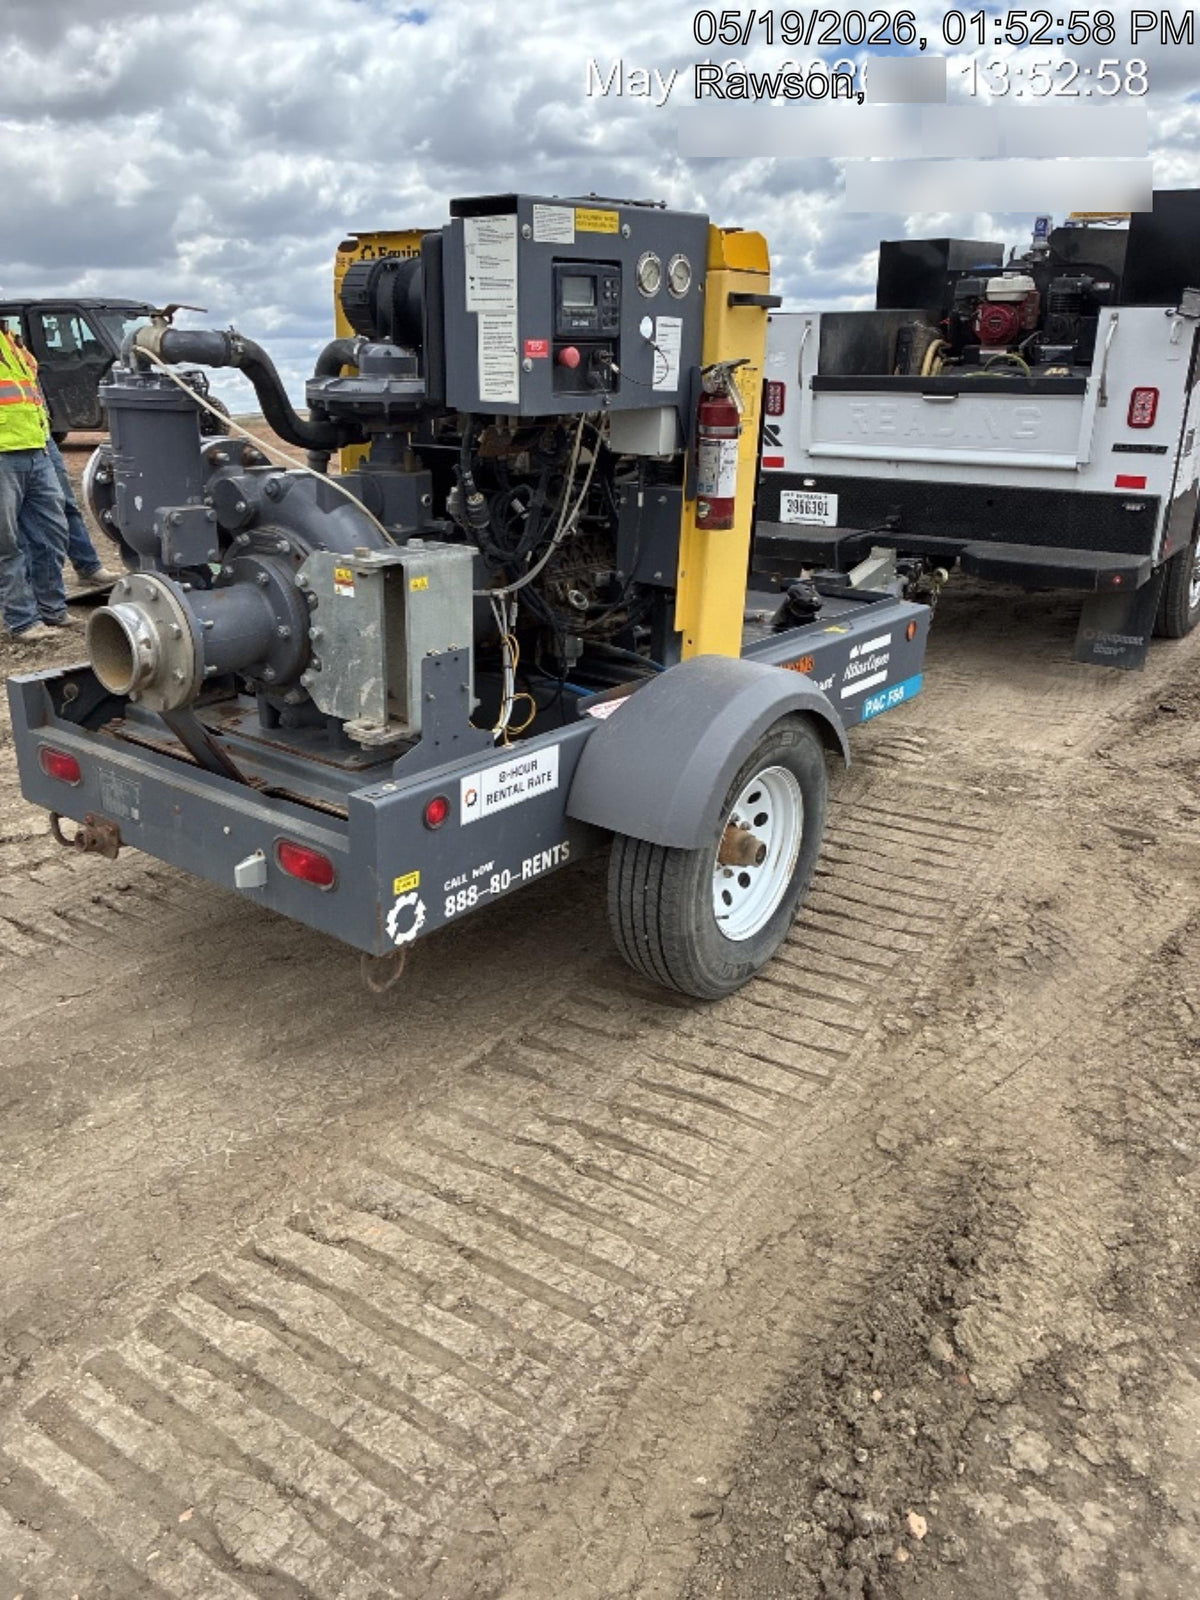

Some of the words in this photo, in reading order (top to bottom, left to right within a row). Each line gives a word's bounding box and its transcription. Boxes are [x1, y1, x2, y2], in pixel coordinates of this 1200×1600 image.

[499, 760, 538, 783] 8-HOUR
[486, 782, 525, 805] RENTAL
[527, 771, 552, 790] RATE
[444, 841, 570, 918] 888-80-RENTS
[444, 873, 468, 891] CALL
